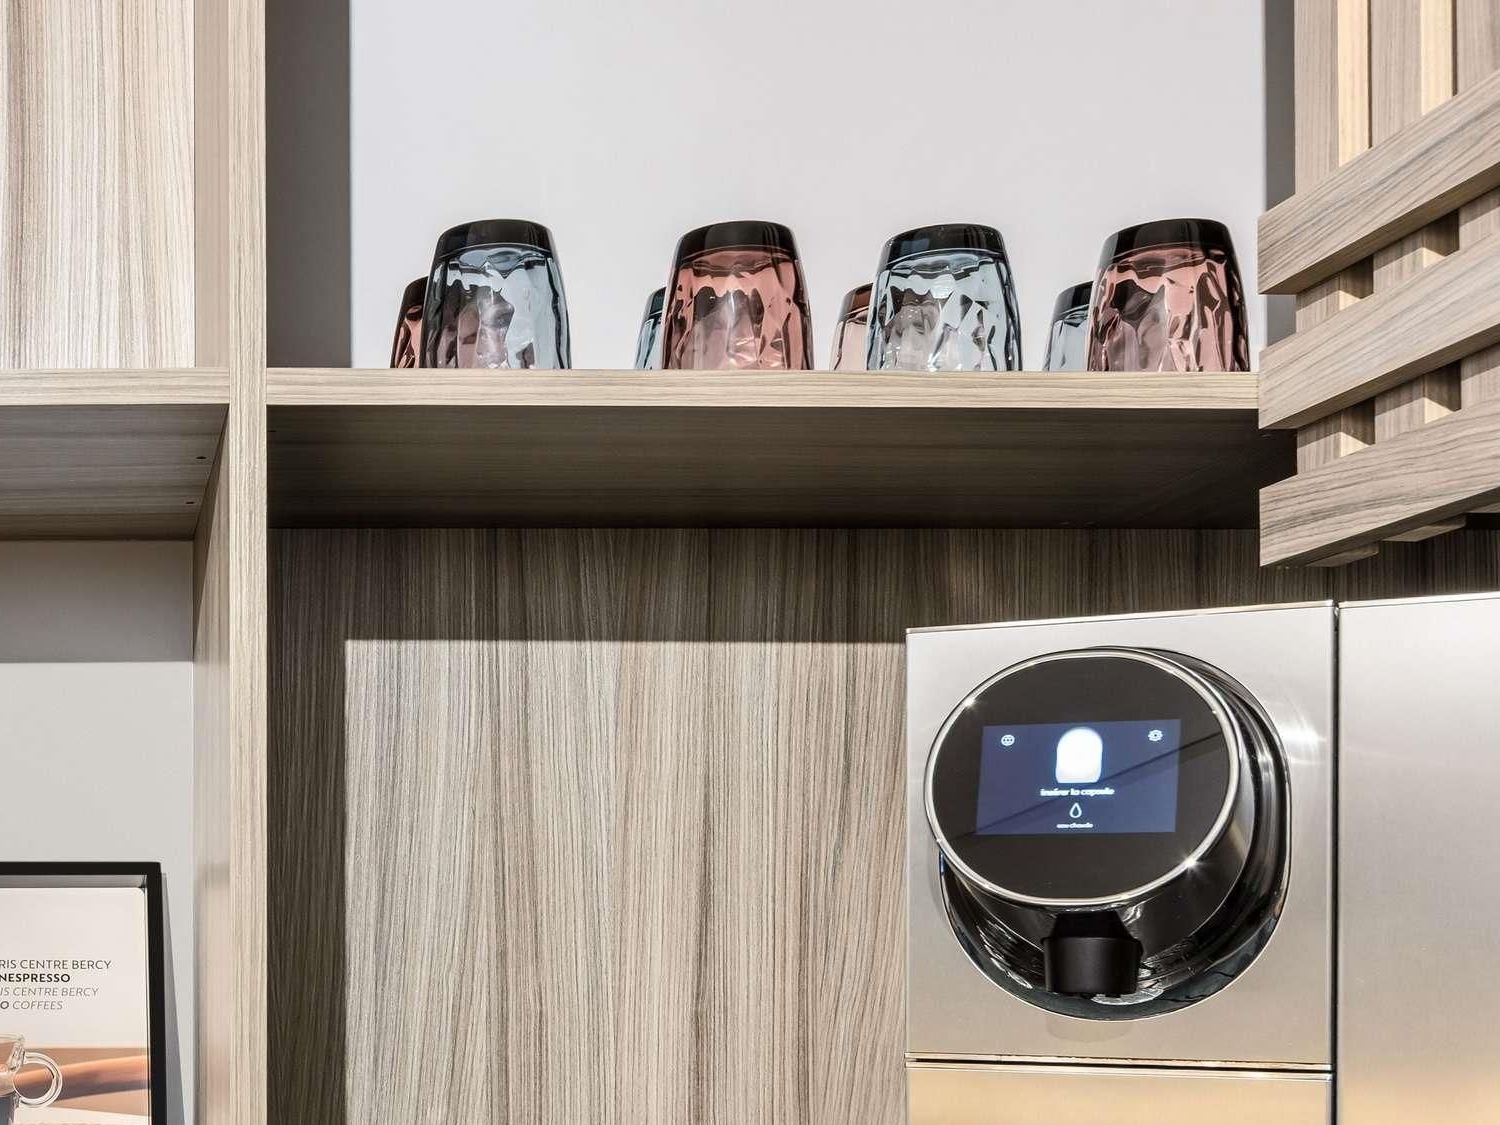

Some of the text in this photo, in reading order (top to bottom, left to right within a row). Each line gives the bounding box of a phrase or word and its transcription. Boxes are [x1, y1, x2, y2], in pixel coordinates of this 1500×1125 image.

[19, 959, 69, 970] CENTRE
[71, 959, 112, 970] BERCY
[12, 986, 58, 997] CENTRE
[61, 986, 100, 997] BERCY
[12, 1000, 63, 1010] COFFEES
